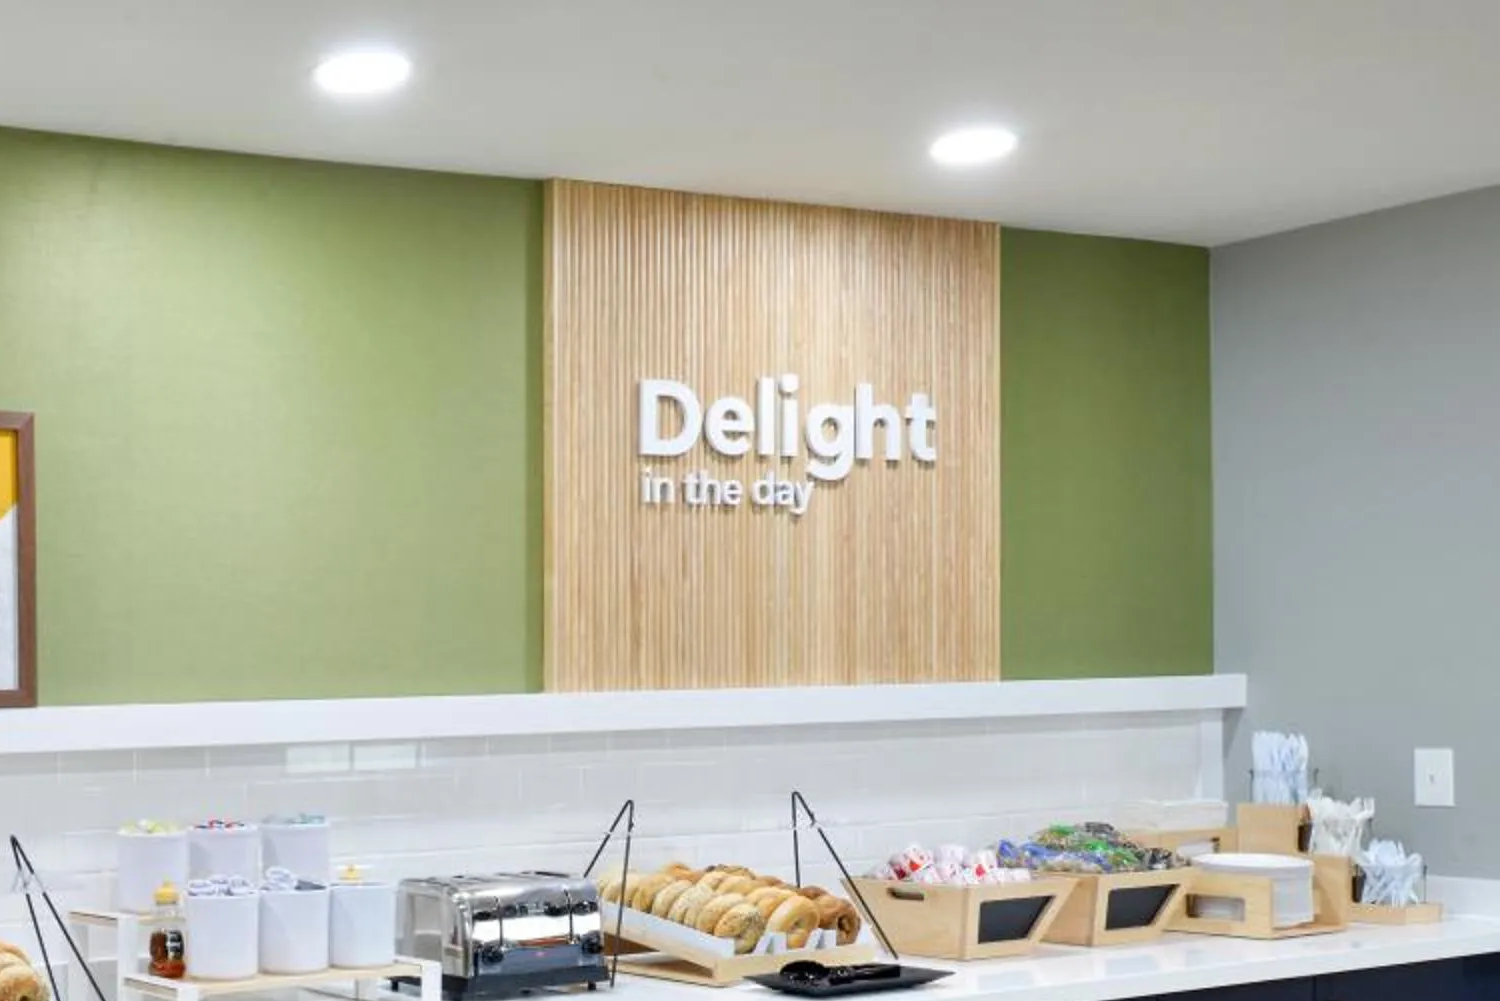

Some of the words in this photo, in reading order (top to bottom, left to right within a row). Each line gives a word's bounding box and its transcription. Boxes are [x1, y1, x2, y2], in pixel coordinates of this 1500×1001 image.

[638, 373, 937, 481] Delight
[641, 466, 674, 504] in
[684, 469, 743, 505] the
[751, 470, 815, 515] day
